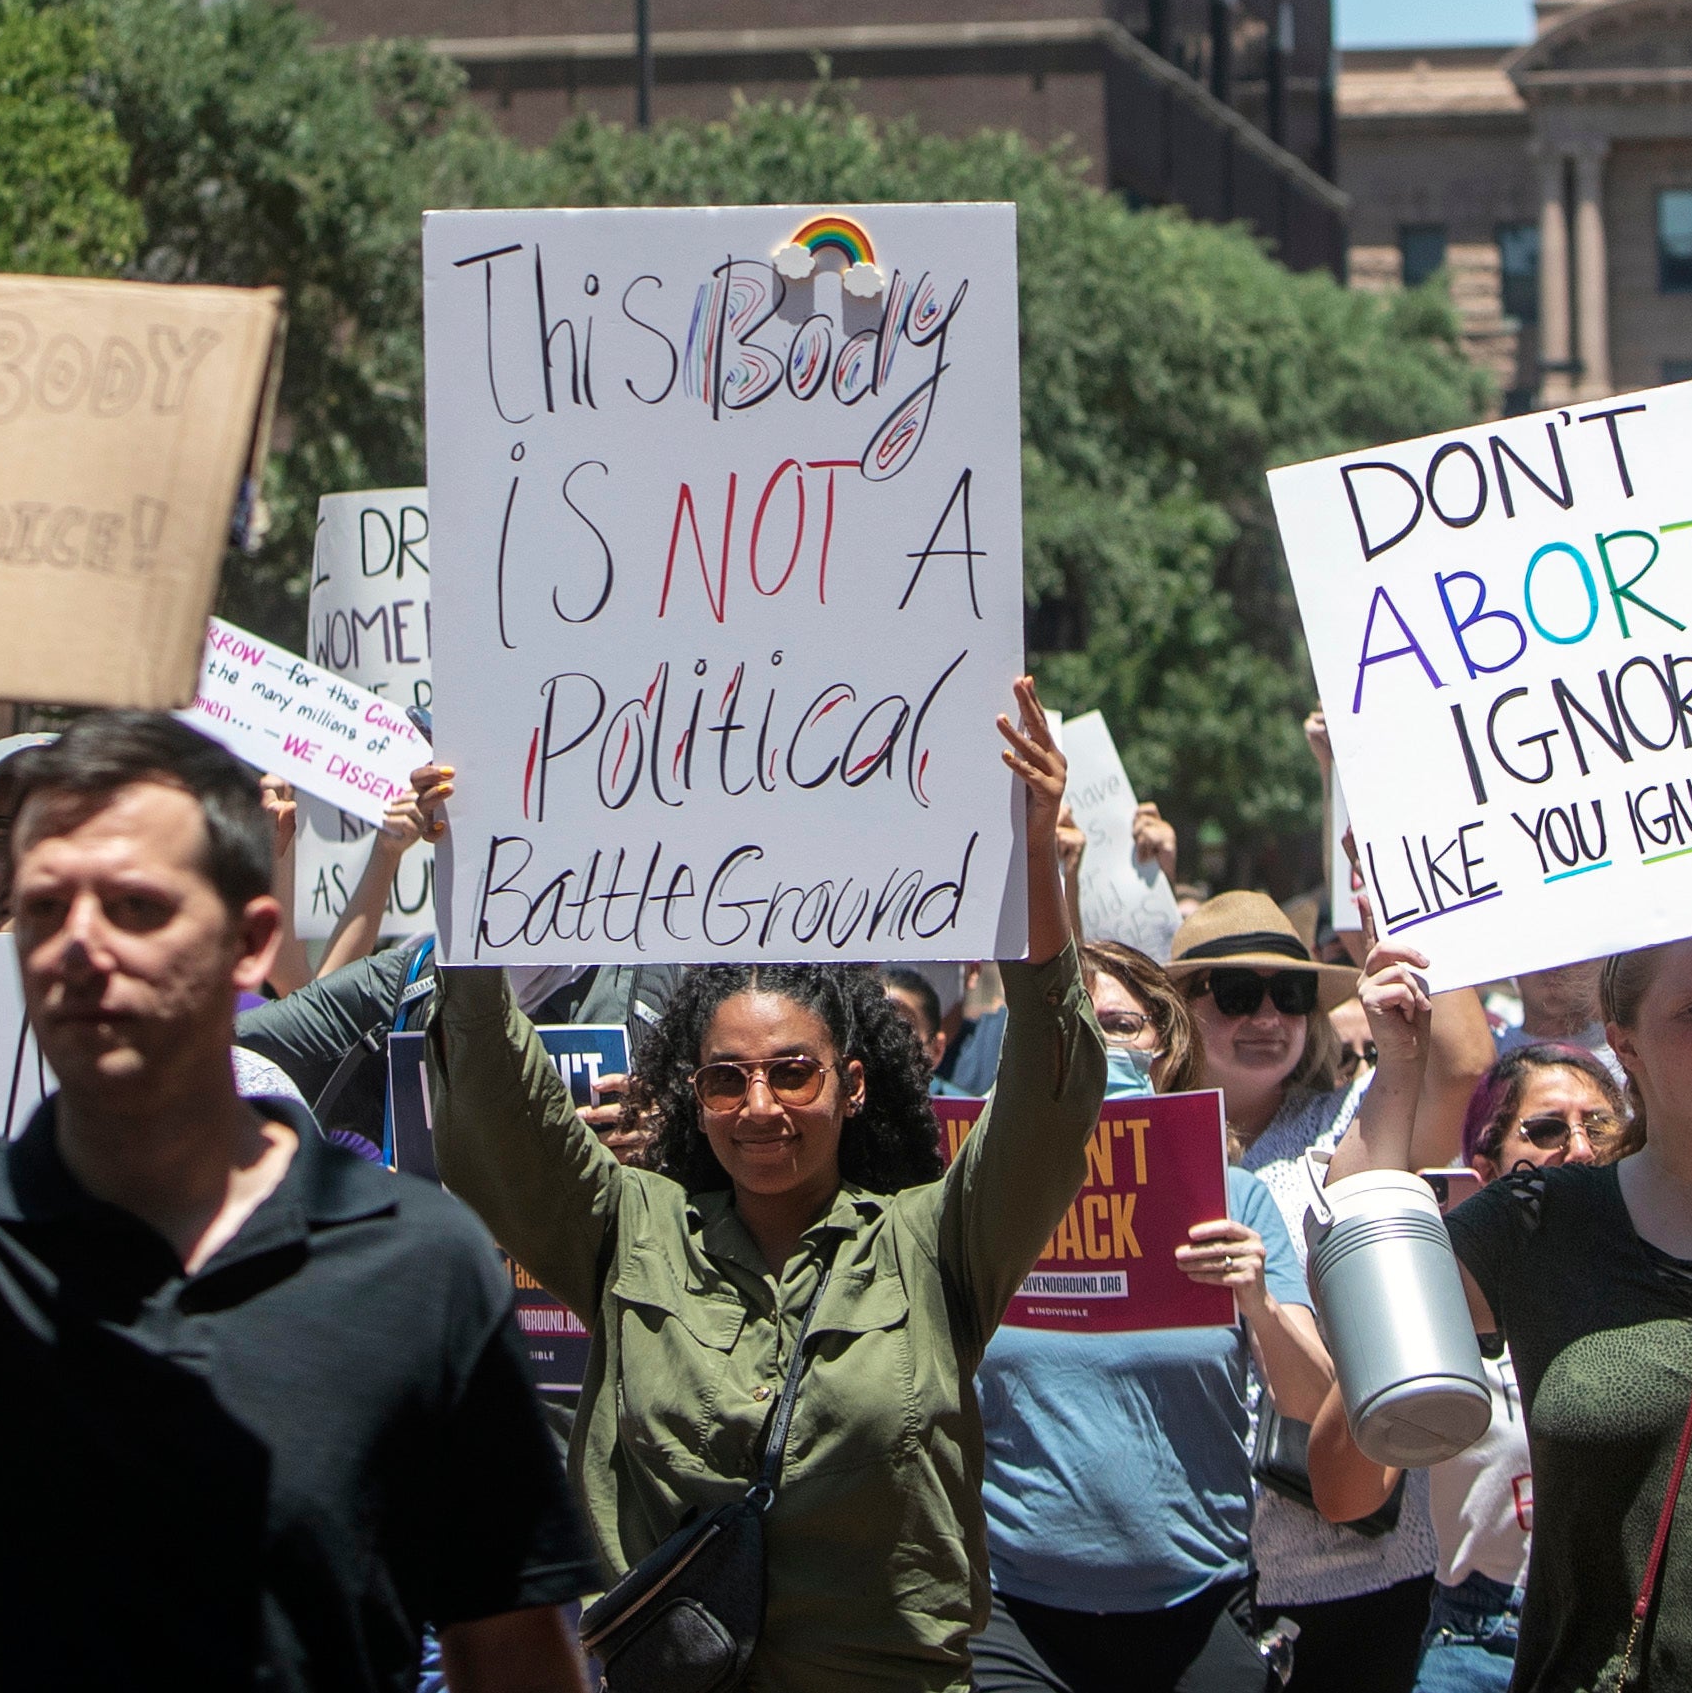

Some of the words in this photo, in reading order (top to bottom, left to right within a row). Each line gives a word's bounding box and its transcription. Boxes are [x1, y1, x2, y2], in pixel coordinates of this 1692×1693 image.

[683, 253, 967, 482] Body
[1340, 404, 1650, 563] DON'T
[659, 458, 863, 624] NOT
[898, 467, 987, 620] A
[206, 625, 266, 666] RROW
[284, 662, 319, 688] for
[326, 684, 359, 711] this
[313, 600, 431, 670] WOME
[207, 659, 239, 684] the
[251, 681, 293, 712] many
[297, 702, 357, 741] millions
[366, 735, 390, 755] of
[523, 649, 968, 822] Political
[283, 732, 323, 761] WE
[326, 753, 404, 801] DISSEN
[1365, 820, 1499, 924] LIKE
[1509, 796, 1609, 876] YOU
[1083, 1118, 1151, 1187] N'T
[1035, 1306, 1089, 1318] INDIVISIBLE
